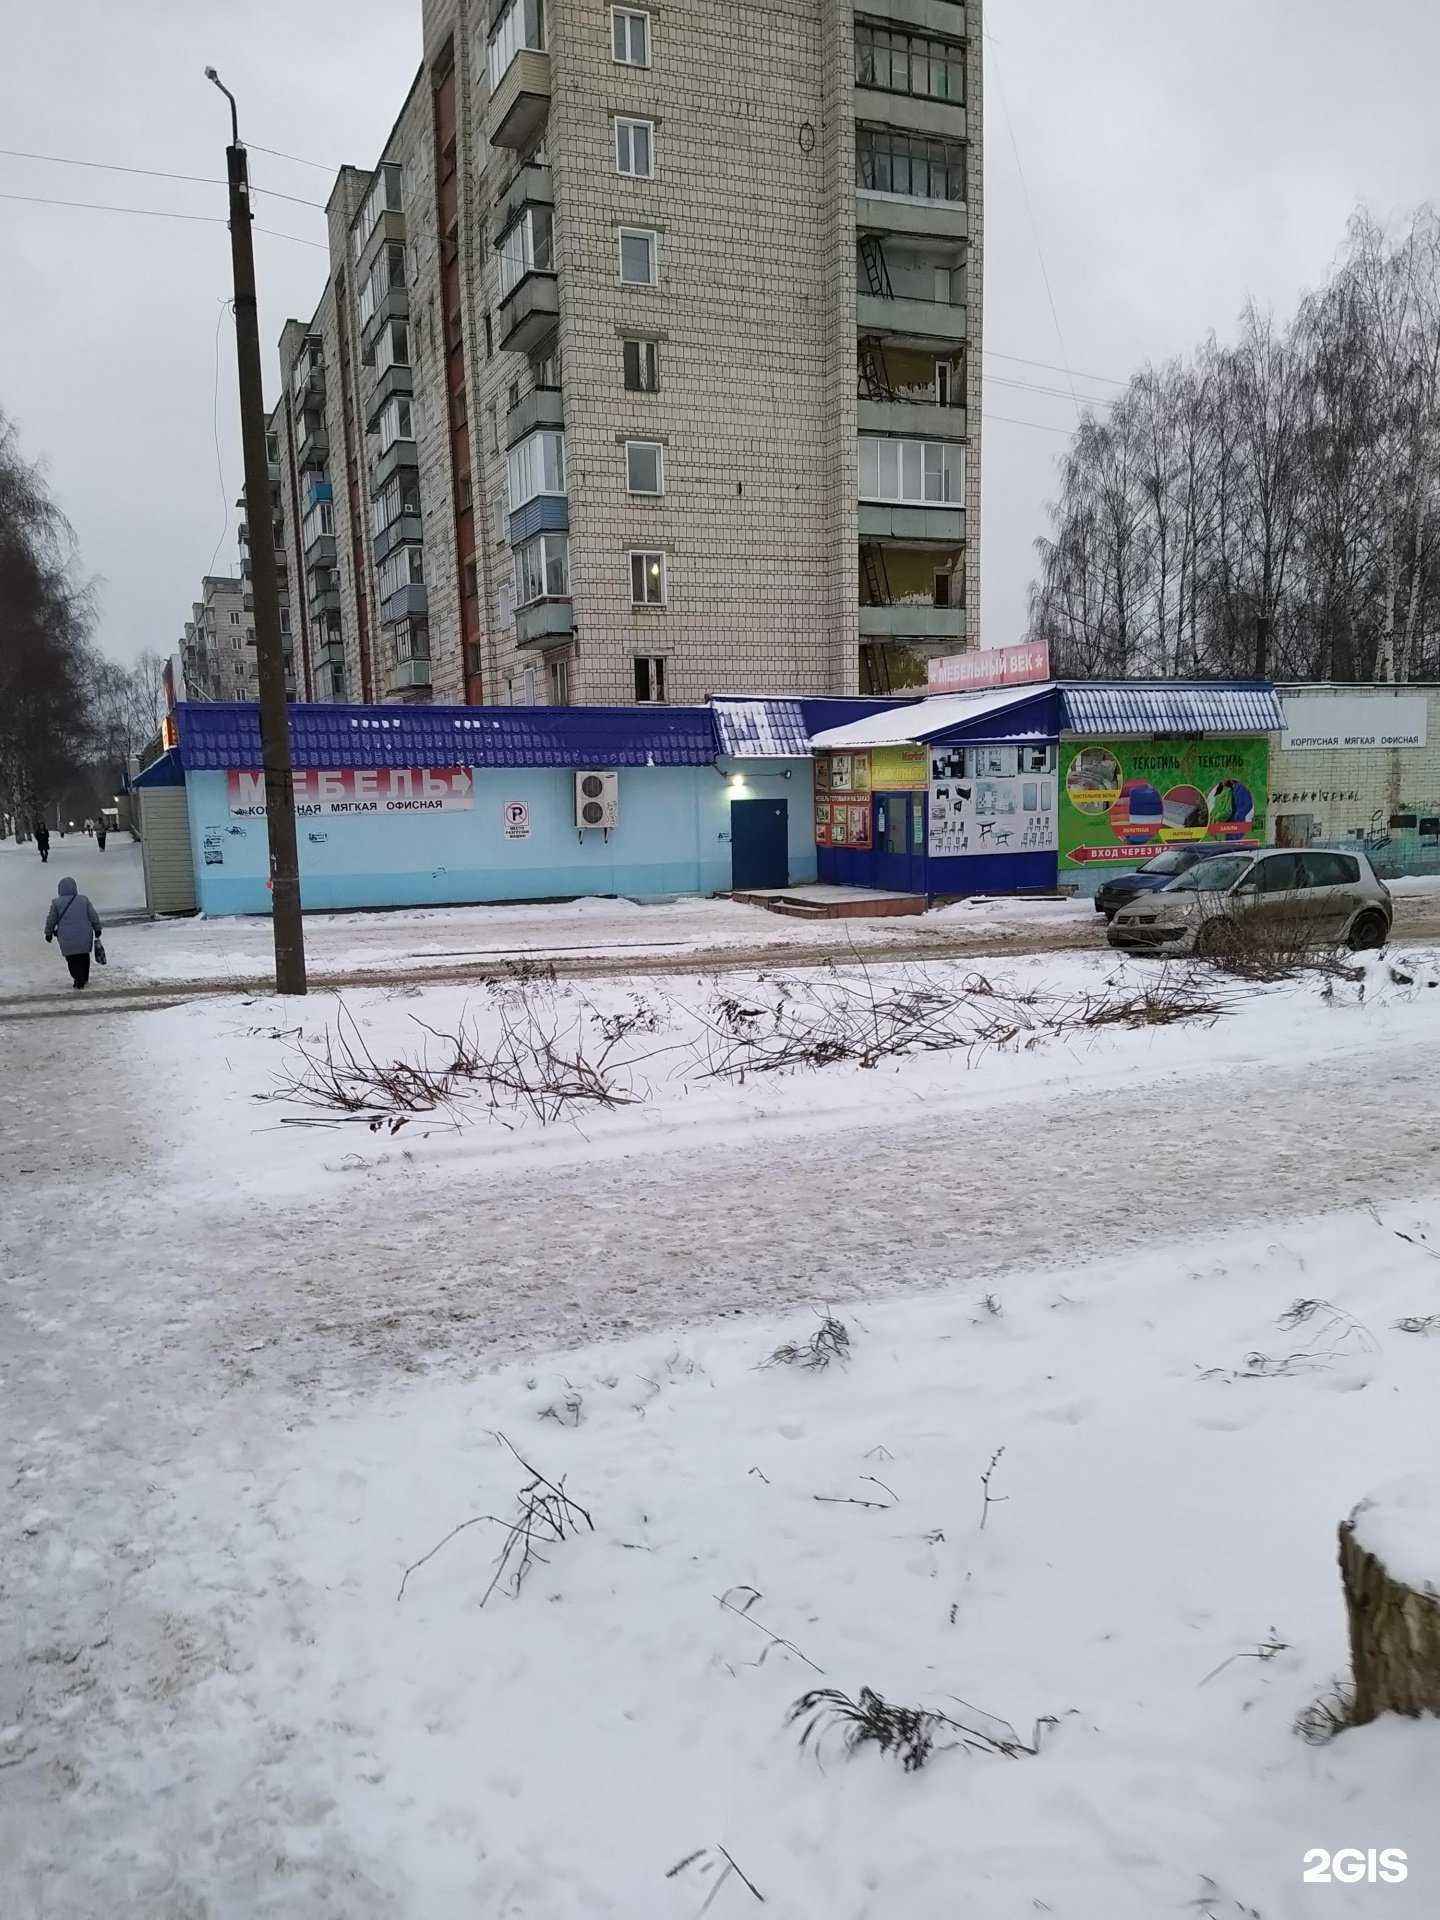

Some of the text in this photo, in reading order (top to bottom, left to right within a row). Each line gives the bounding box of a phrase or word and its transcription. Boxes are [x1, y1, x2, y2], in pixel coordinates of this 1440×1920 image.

[1010, 653, 1033, 673] ВЕК
[1290, 735, 1419, 747] КОРПУСНАЯ МЯГКАЯ ОФИСНАЯ
[1132, 753, 1244, 770] ТЕКСТИЛЬ ТЕКСТИЛЬ
[248, 800, 443, 817] КОНАЯ МЯГКАЯ ОФИСНАЯ
[1091, 848, 1119, 858] ВХОД
[1121, 846, 1152, 857] ЧЕРЕЗ
